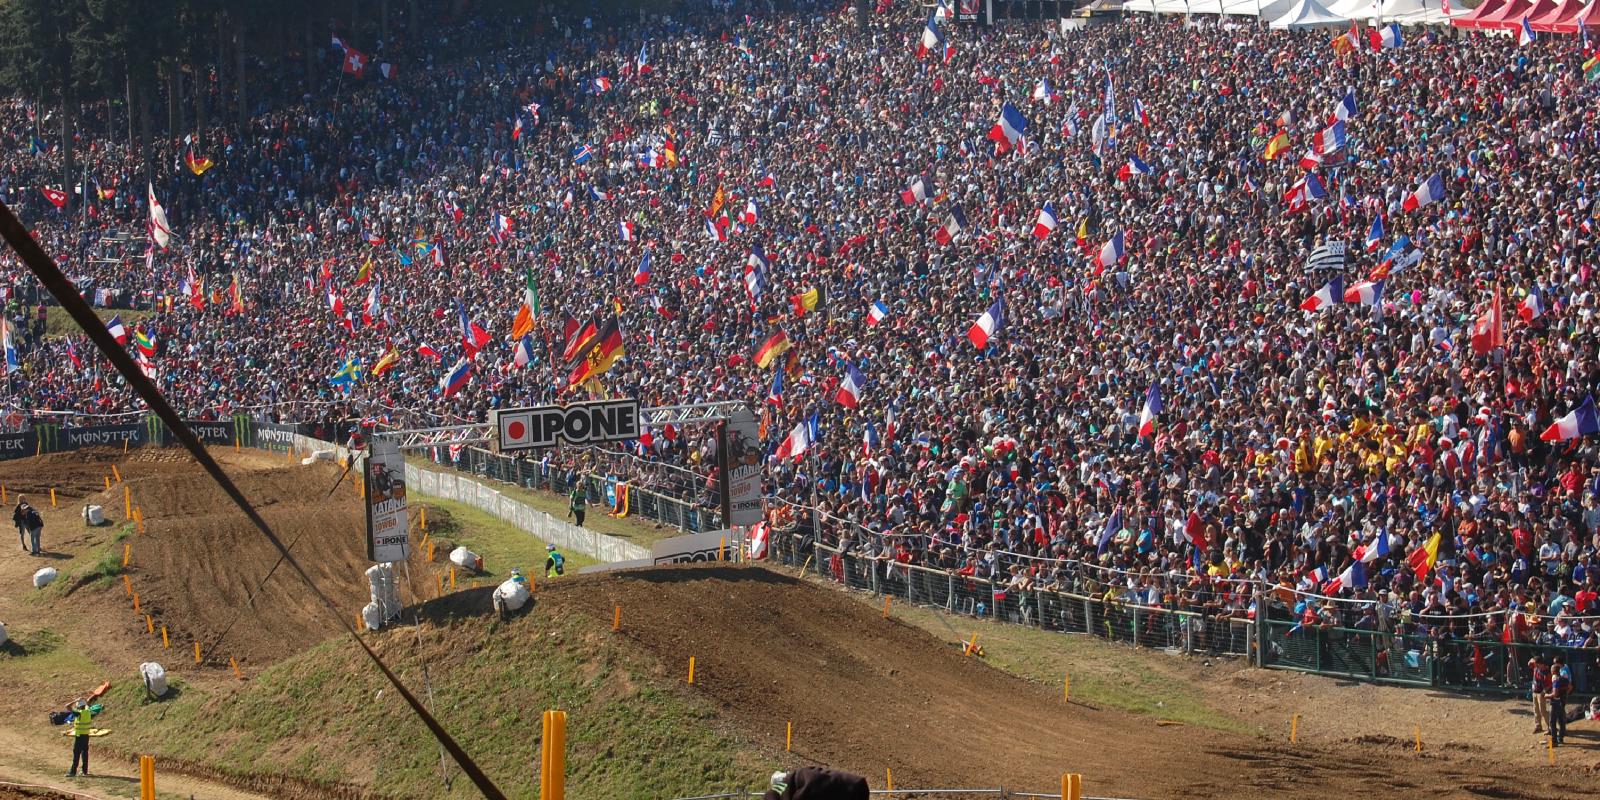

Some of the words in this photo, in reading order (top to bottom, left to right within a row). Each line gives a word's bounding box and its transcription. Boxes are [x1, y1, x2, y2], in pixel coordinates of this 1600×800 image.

[532, 406, 635, 443] IPONE
[71, 429, 139, 445] MONSTER
[258, 426, 294, 443] MONSTER
[728, 462, 760, 481] KATANA
[374, 496, 408, 515] KATANA
[382, 535, 407, 545] IPONE
